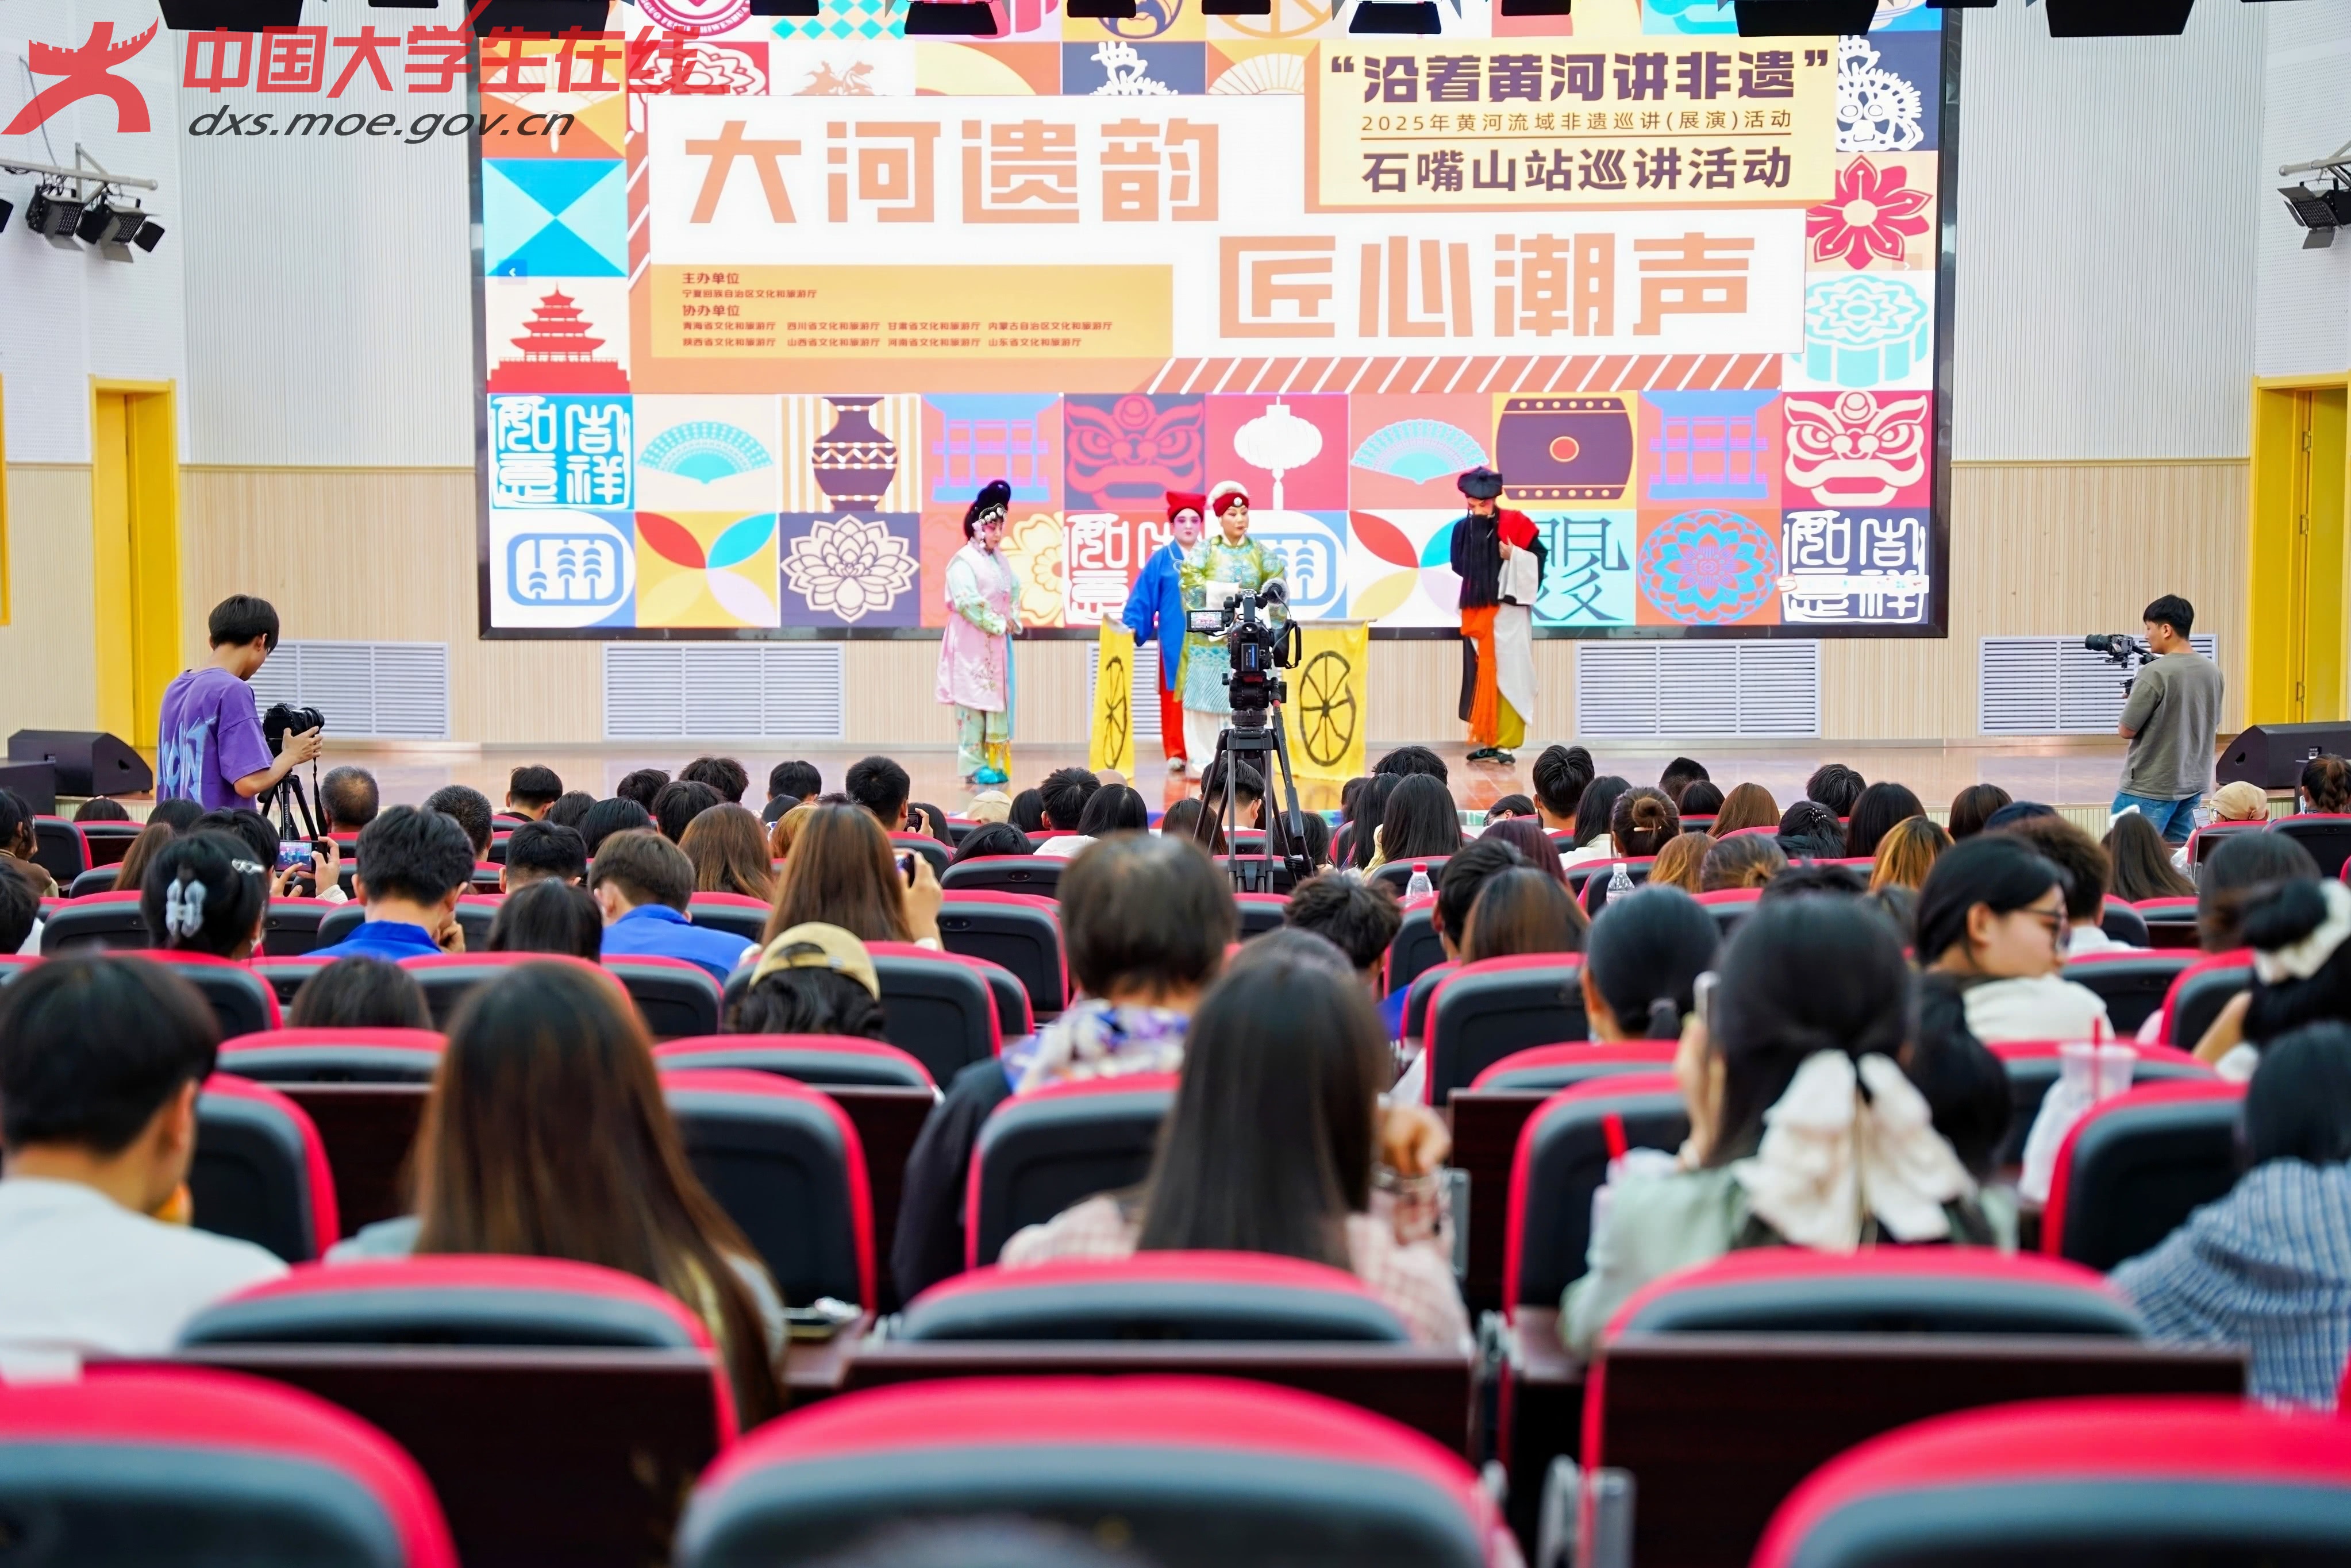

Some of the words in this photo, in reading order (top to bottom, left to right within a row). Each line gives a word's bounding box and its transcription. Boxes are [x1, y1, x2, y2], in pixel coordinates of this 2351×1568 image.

[1331, 49, 1828, 103] “沿着黄河讲非遗”
[685, 118, 1219, 224] 大河遗韵
[1361, 146, 1791, 193] 石嘴山站巡讲活动
[682, 272, 740, 284] 主办单位
[1219, 232, 1754, 338] 匠心潮声
[682, 289, 817, 298] 宁夏回族自治区文化和旅游厅
[683, 305, 740, 317] 协办单位
[683, 321, 776, 330] 青海省文化和旅游厅
[787, 321, 880, 331] 四川省文化和旅游厅
[888, 322, 980, 331] 甘肃省文化和旅游厅
[988, 322, 1113, 331] 内蒙古自治区文化和旅游厅
[683, 337, 776, 347] 陕西省文化和旅游厅
[787, 337, 880, 347] 山西省文化和旅游厅
[888, 338, 980, 347] 河南省文化和旅游厅
[988, 338, 1082, 347] 山东省文化和旅游厅
